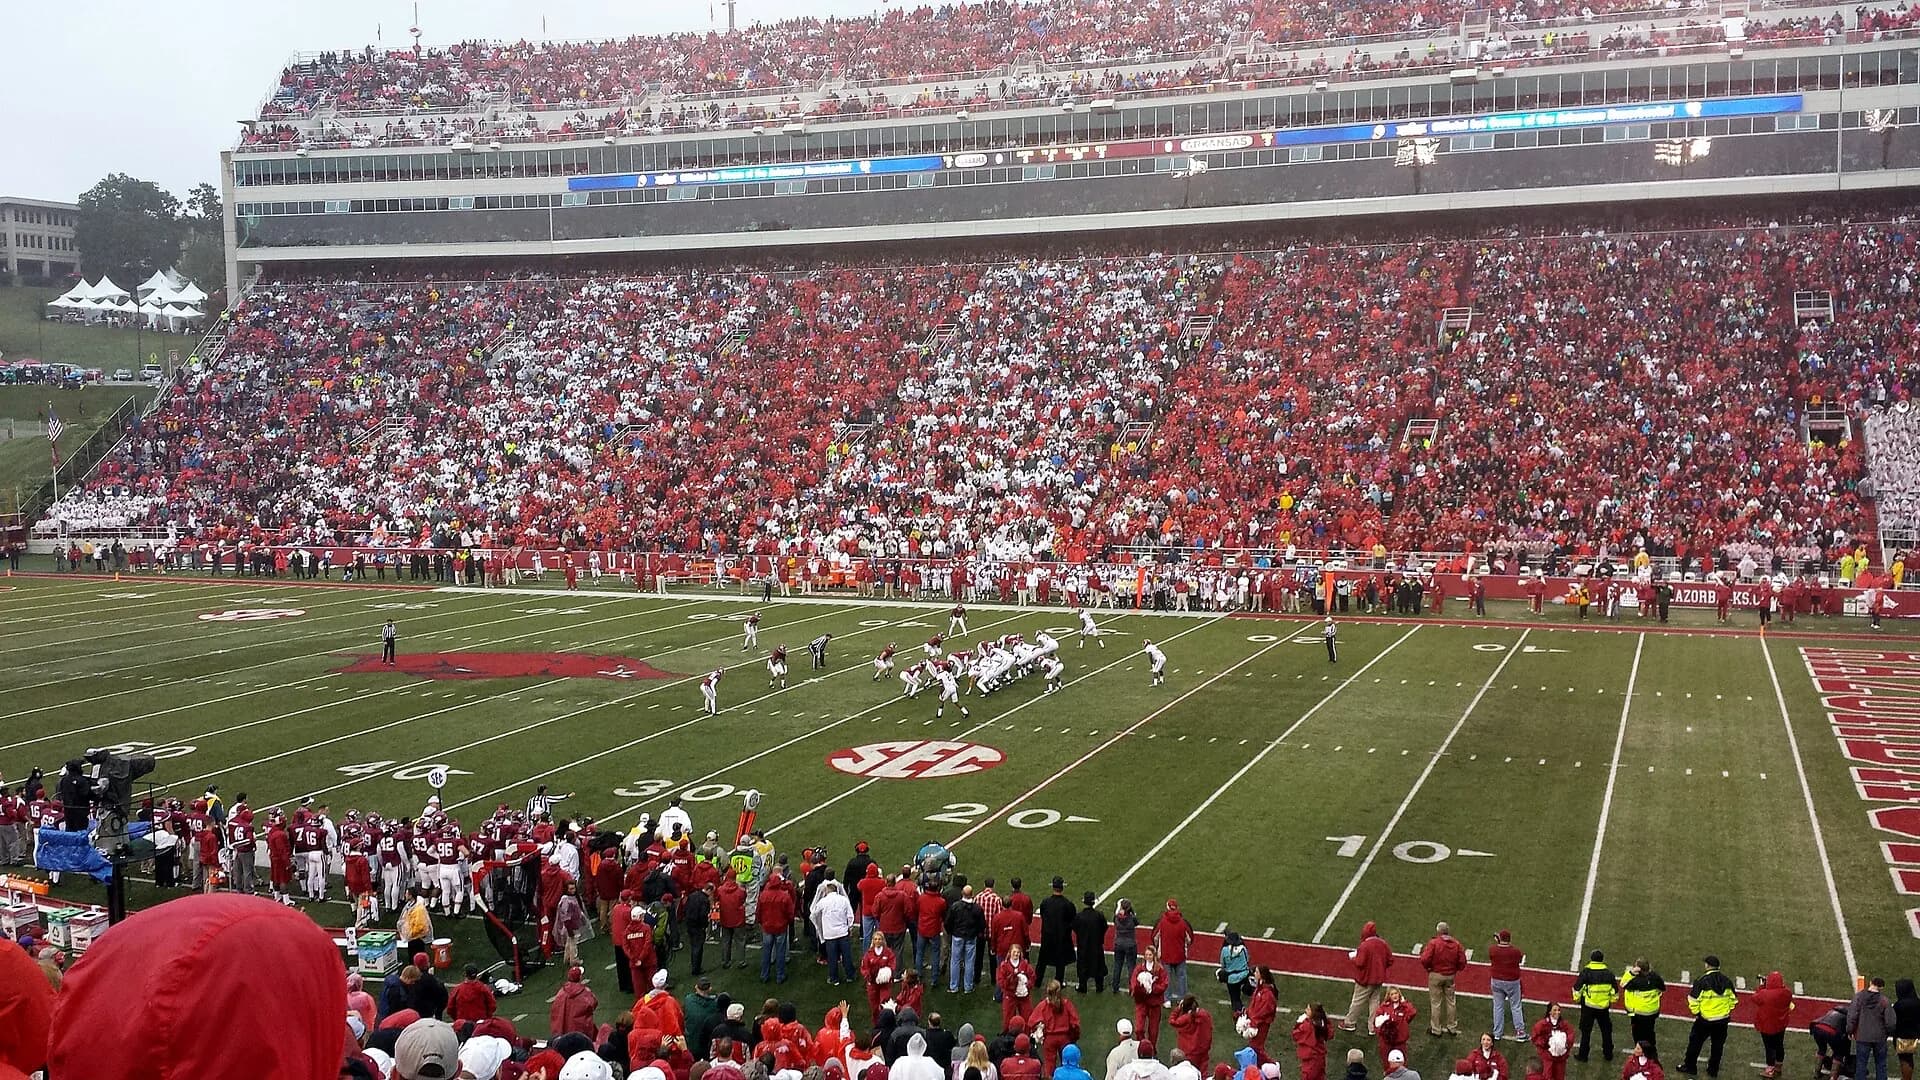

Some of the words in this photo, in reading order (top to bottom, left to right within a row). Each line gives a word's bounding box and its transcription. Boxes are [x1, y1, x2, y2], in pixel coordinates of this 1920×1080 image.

[1186, 136, 1247, 149] ARKANSAS
[832, 741, 1002, 779] SEC
[336, 760, 450, 780] 40
[613, 778, 735, 802] 30
[923, 803, 1063, 829] 20
[306, 832, 317, 846] 16
[412, 838, 427, 851] 93
[470, 840, 485, 855] 97
[437, 842, 453, 857] 96
[1325, 835, 1452, 864] 10
